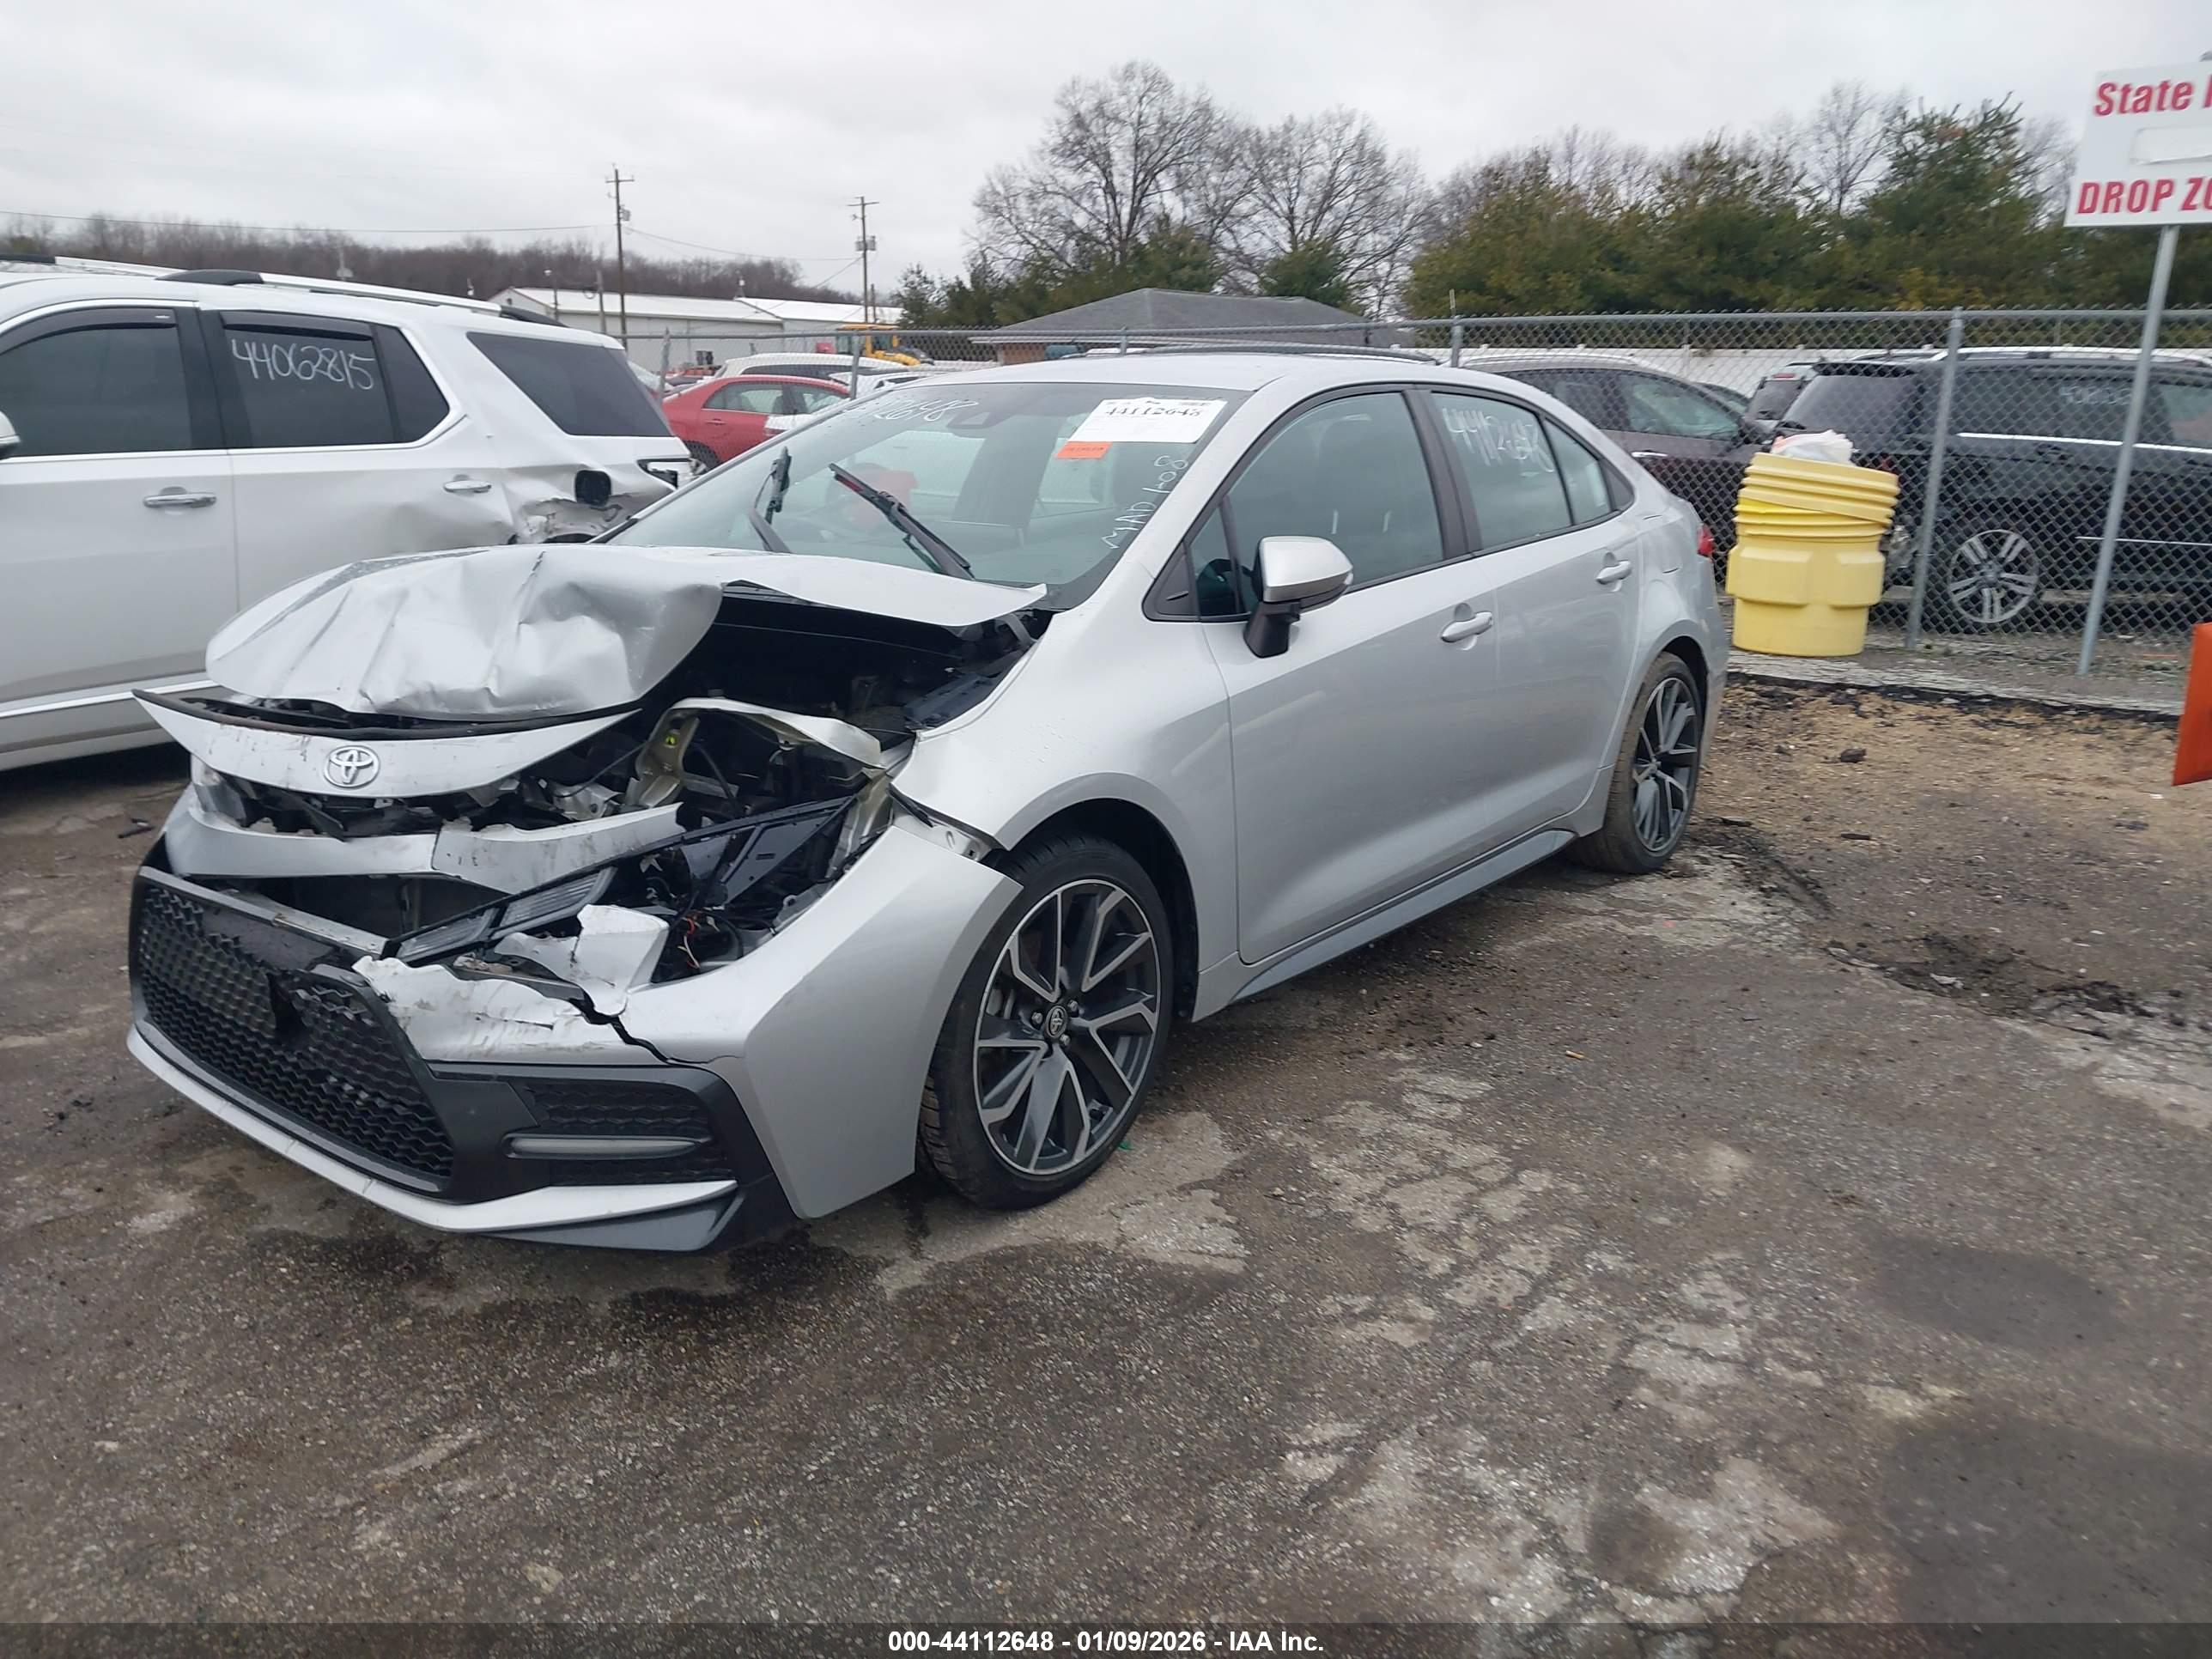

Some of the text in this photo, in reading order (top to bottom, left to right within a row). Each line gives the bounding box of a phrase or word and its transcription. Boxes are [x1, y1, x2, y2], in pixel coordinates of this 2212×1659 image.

[2094, 79, 2194, 116] State
[2076, 179, 2175, 214] DROP
[232, 338, 375, 390] 44062815
